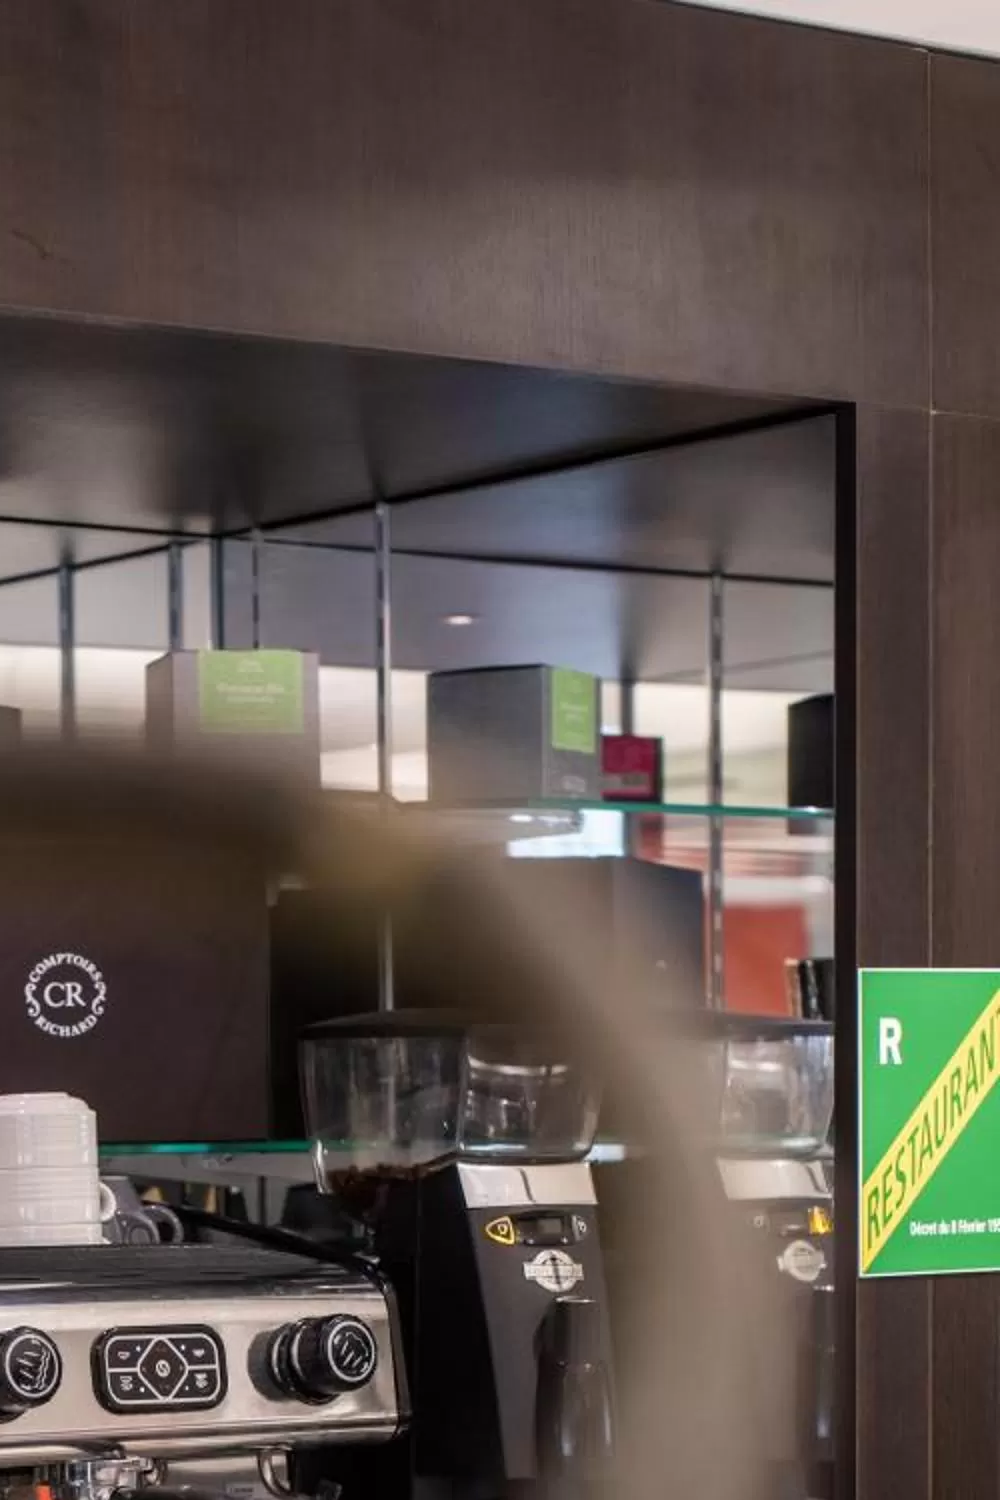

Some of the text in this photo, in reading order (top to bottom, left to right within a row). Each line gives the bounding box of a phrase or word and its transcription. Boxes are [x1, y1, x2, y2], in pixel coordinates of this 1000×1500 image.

[29, 953, 102, 982] COMPTOIRS
[43, 981, 86, 1008] CR
[34, 1014, 98, 1037] RICHARD
[879, 1016, 903, 1065] R
